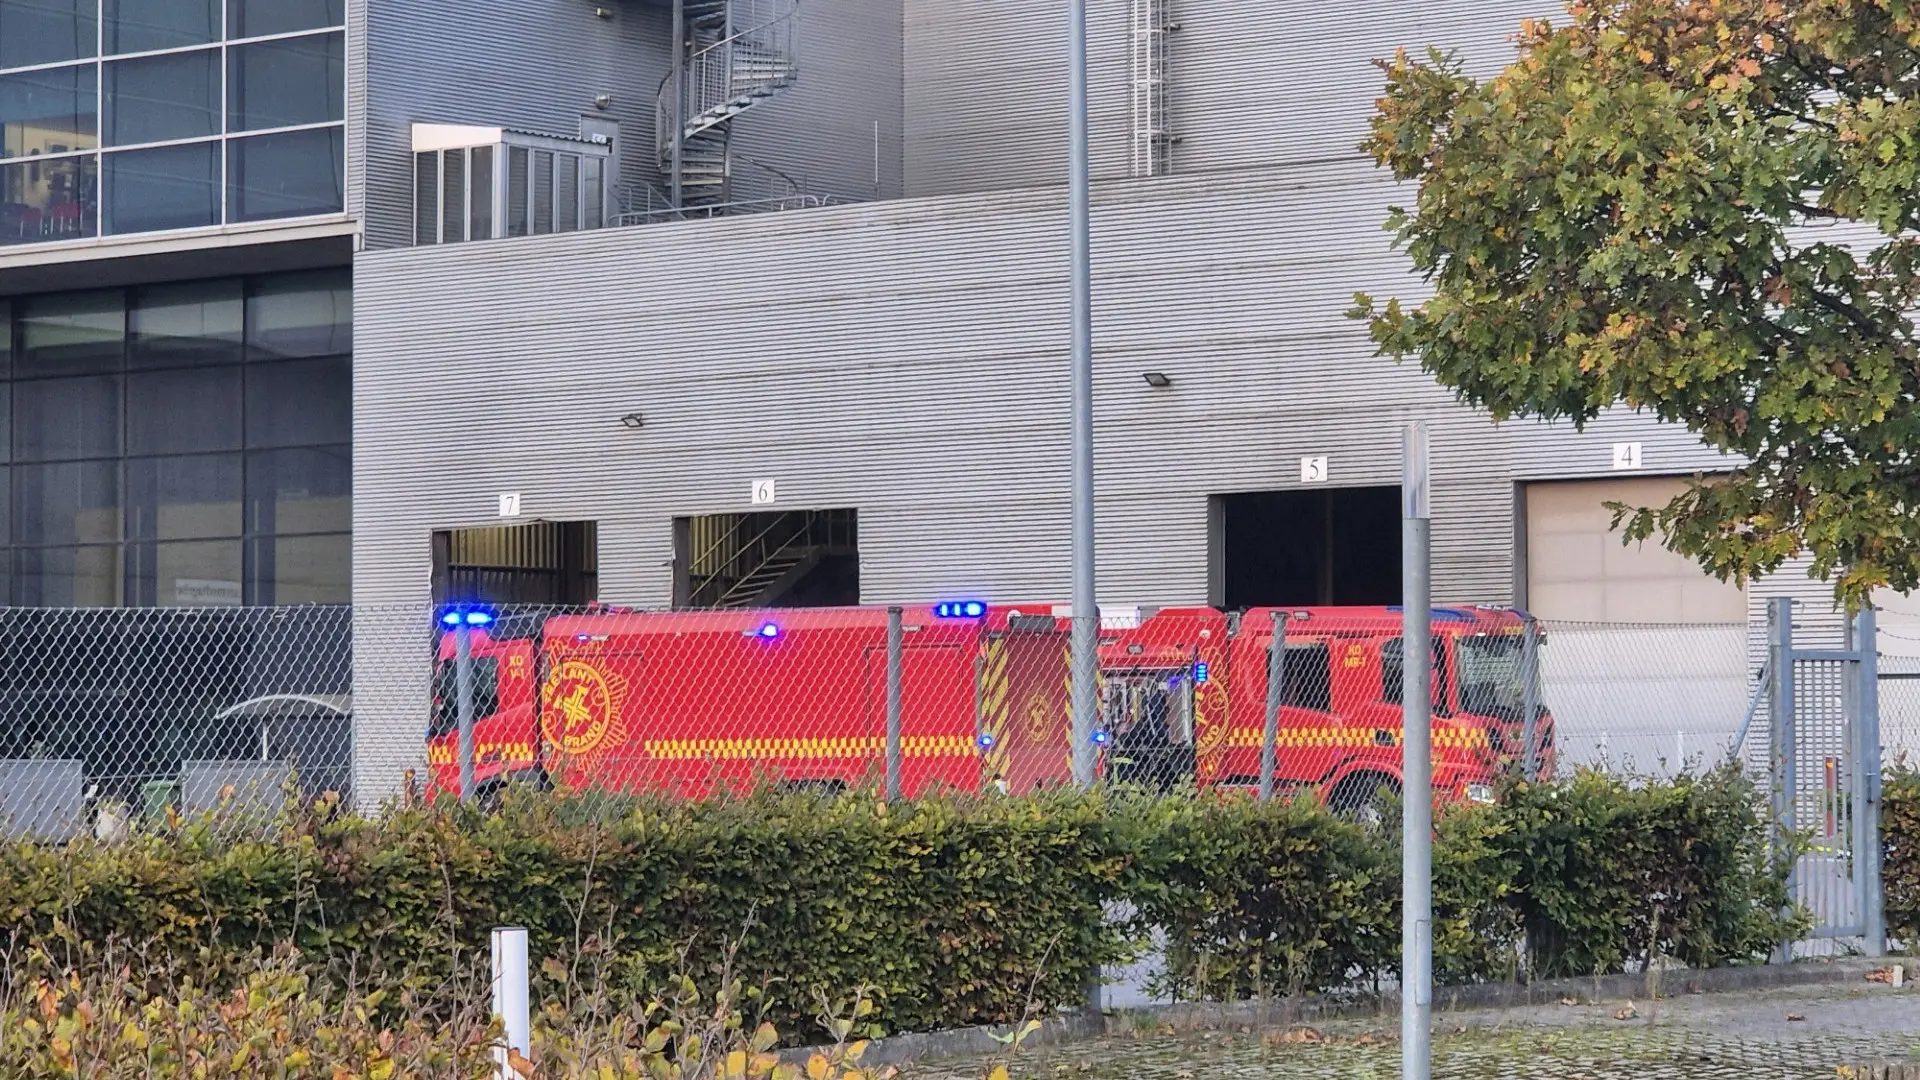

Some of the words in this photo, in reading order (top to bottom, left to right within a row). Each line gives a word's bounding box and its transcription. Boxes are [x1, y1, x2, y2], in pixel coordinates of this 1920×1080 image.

[1621, 445, 1633, 466] 4
[1309, 459, 1319, 480] 5
[758, 482, 768, 502] 6
[505, 495, 515, 512] 7
[564, 720, 601, 747] BRAND
